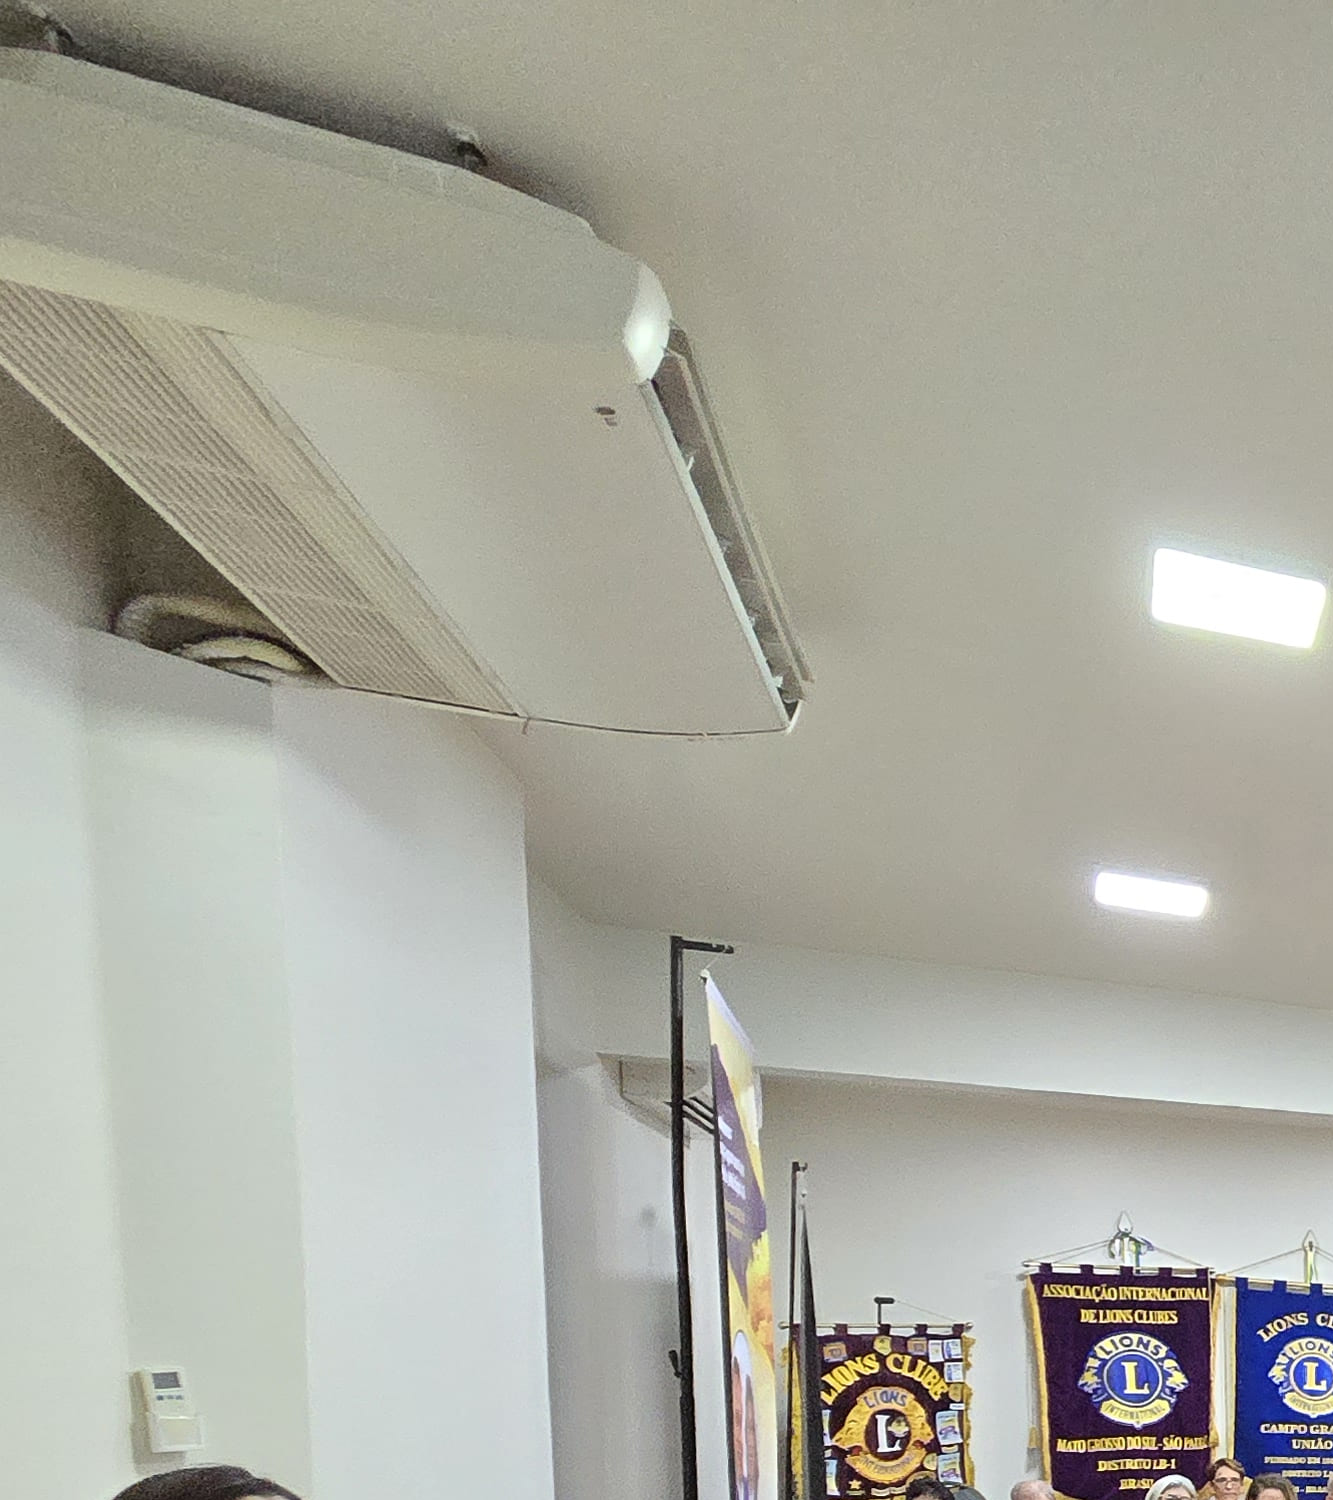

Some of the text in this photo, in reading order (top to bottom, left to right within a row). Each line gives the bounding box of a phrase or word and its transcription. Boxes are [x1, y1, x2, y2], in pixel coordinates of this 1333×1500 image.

[1042, 1284, 1208, 1302] ASSOCIAÇÃO INTERNACIONAL
[1080, 1309, 1097, 1323] DE
[1099, 1309, 1133, 1324] LIONS
[1256, 1312, 1309, 1342] LIONS
[1098, 1336, 1162, 1356] LIONS
[820, 1353, 949, 1406] LIONS CLUBE
[1121, 1361, 1150, 1394] L
[1303, 1361, 1327, 1391] L
[863, 1390, 908, 1409] LIONS
[875, 1414, 902, 1452] L
[1260, 1423, 1308, 1435] CAMPO
[1056, 1438, 1086, 1453] MATO
[1087, 1436, 1126, 1451] GROSSO
[1162, 1435, 1183, 1451] SÃO
[1291, 1438, 1333, 1450] UNIÃO
[1097, 1458, 1176, 1472] DISTRITO LB-1
